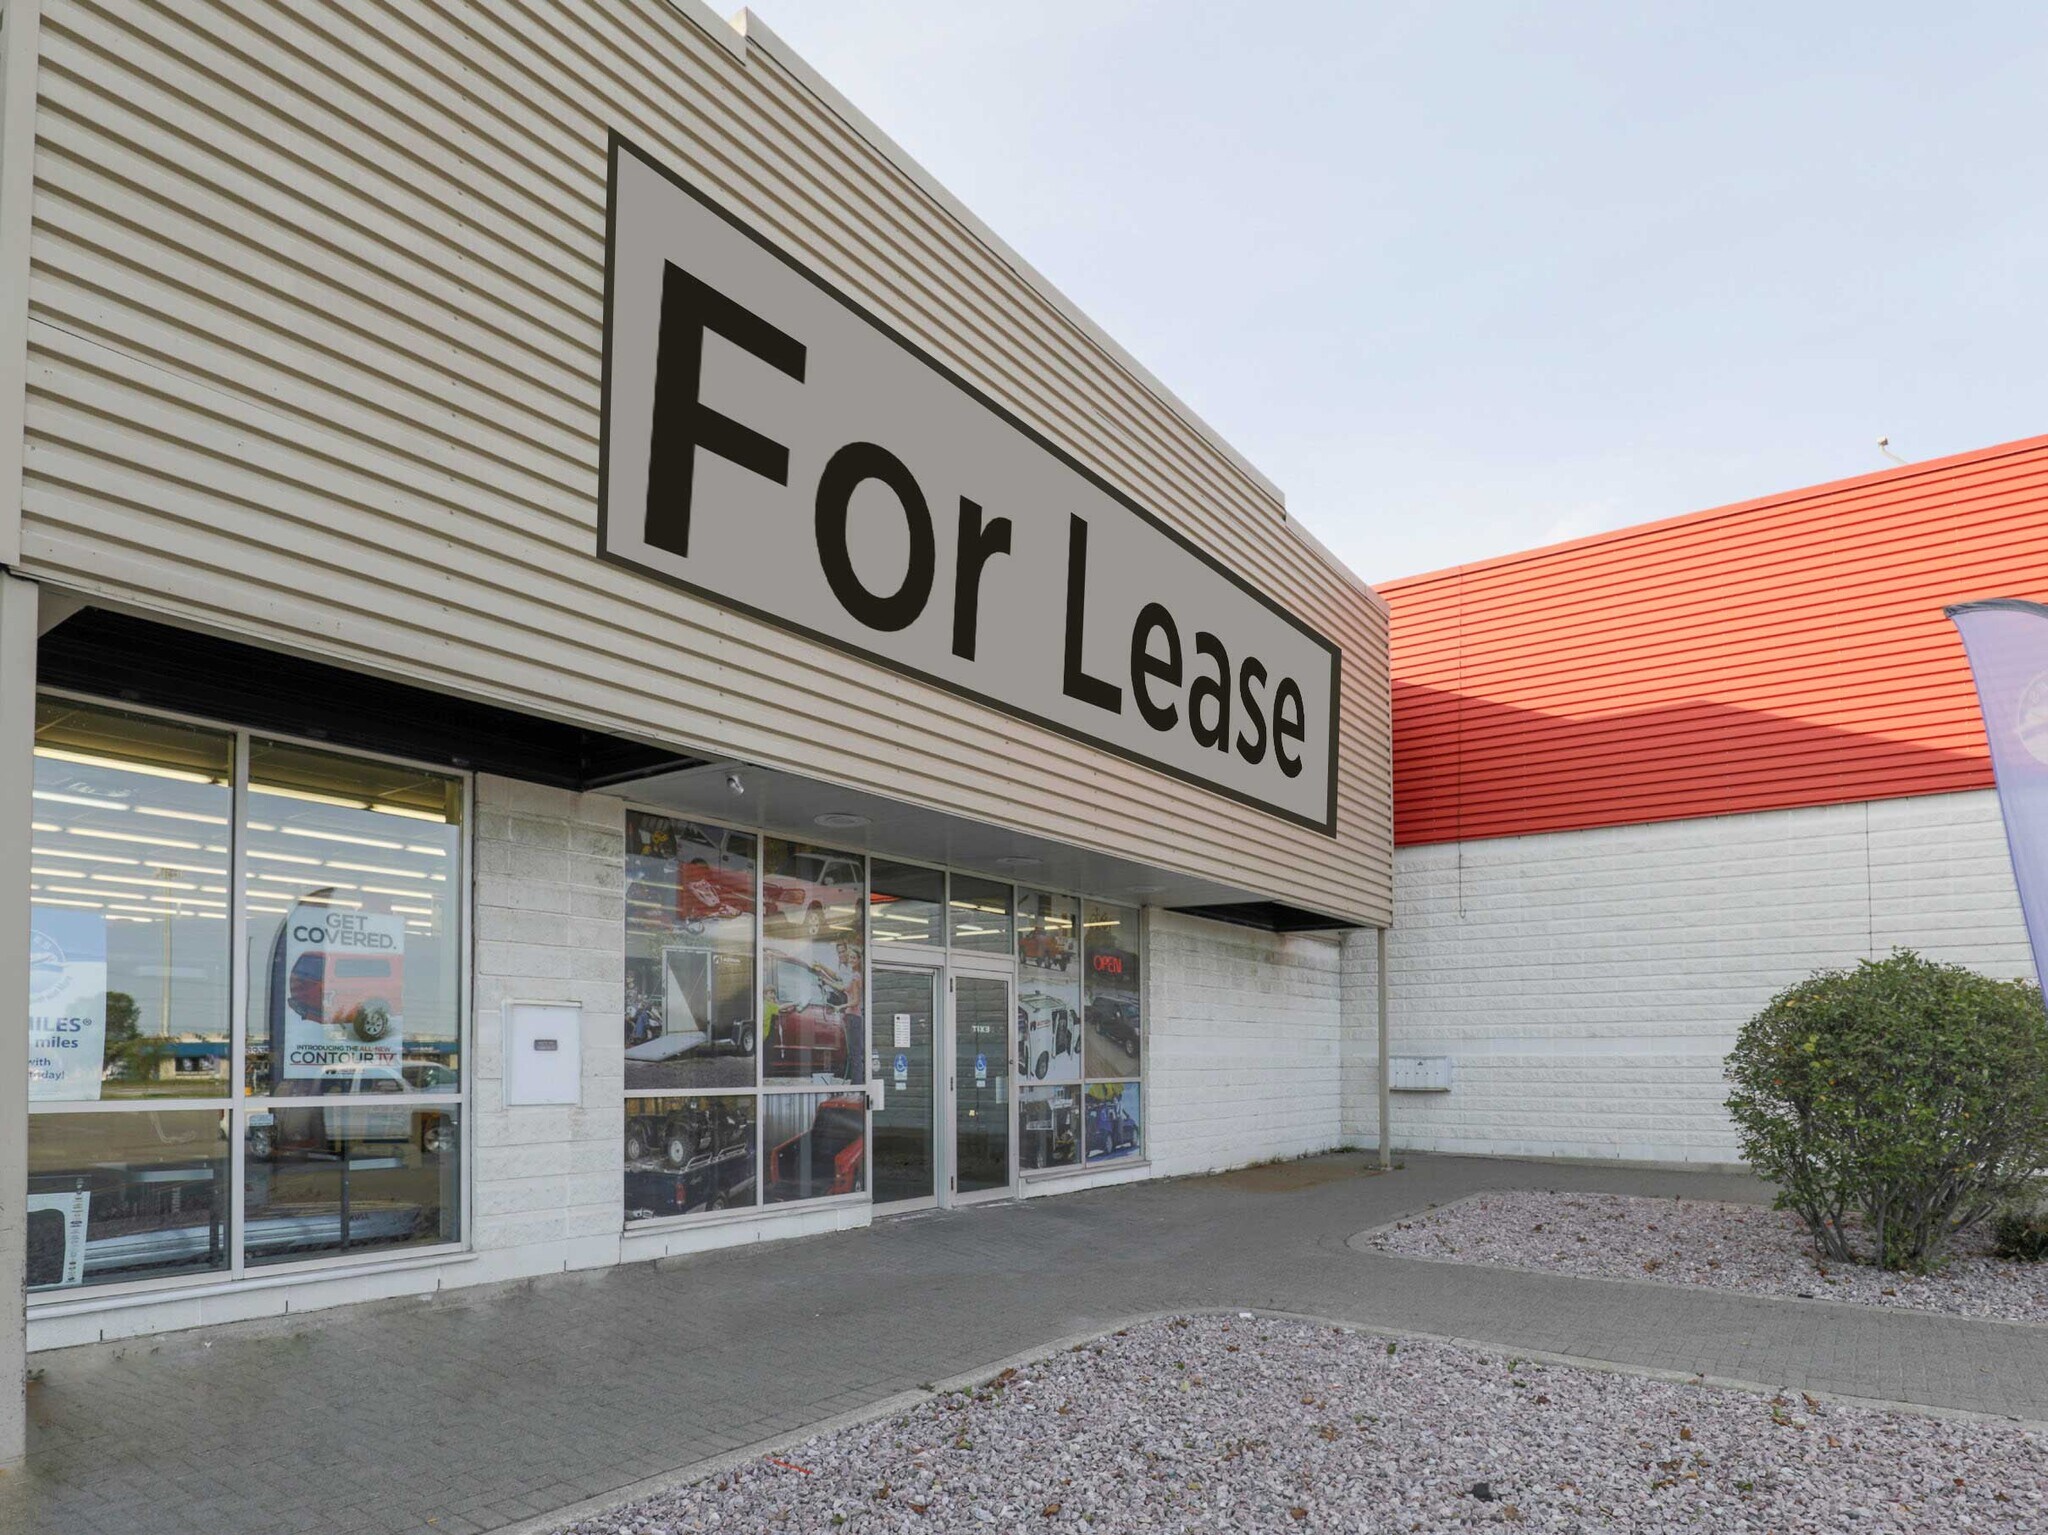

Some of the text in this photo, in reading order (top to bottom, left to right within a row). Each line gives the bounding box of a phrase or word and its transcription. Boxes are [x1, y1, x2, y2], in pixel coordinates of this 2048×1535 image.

[644, 258, 1306, 778] For Lease
[326, 912, 368, 931] GET
[293, 925, 397, 950] COVERED.
[1094, 955, 1122, 974] OPEN
[35, 1036, 79, 1048] miles
[296, 1044, 344, 1052] INTRODUCING
[290, 1051, 374, 1065] CONTOUR
